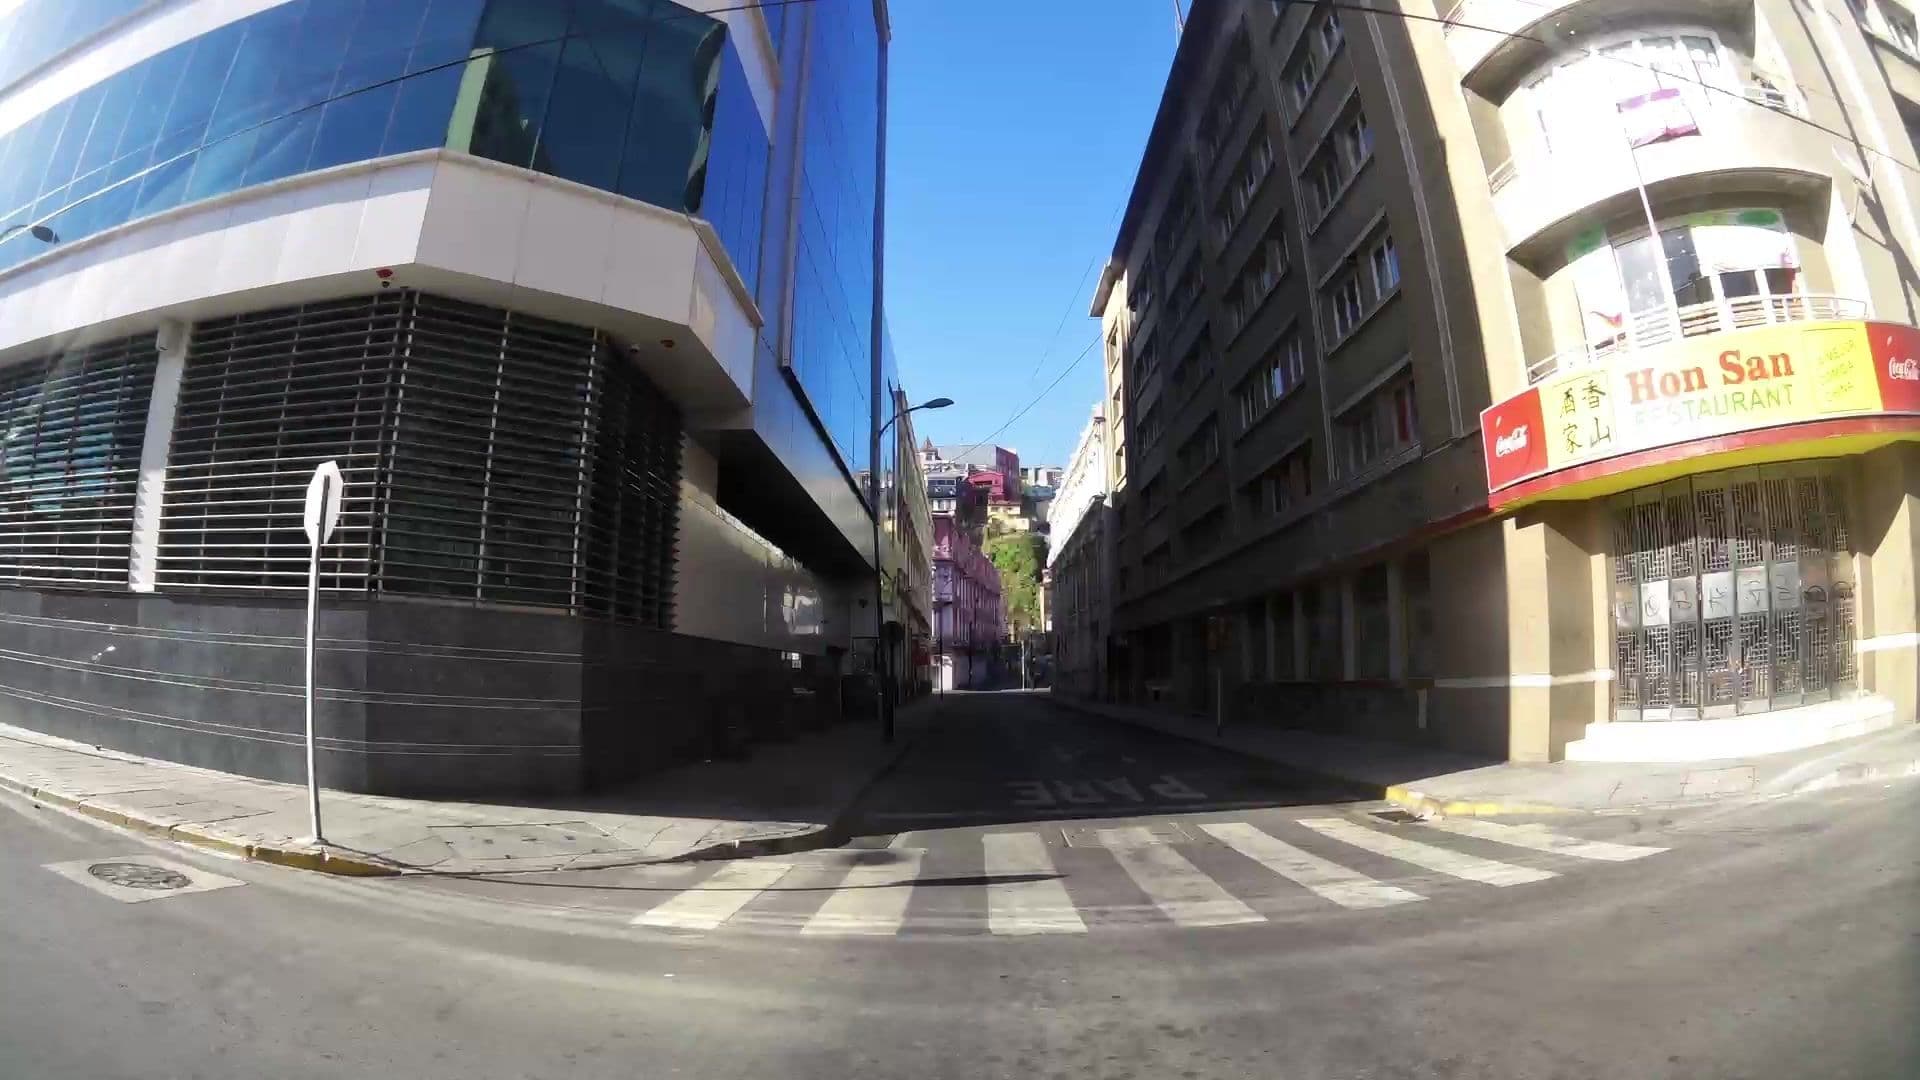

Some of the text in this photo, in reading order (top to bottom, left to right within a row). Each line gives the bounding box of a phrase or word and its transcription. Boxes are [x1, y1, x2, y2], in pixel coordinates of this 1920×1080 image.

[1625, 367, 1708, 405] Hon
[1719, 350, 1795, 385] San
[1632, 384, 1793, 426] RESTAURANT
[1003, 773, 1208, 806] PARE
